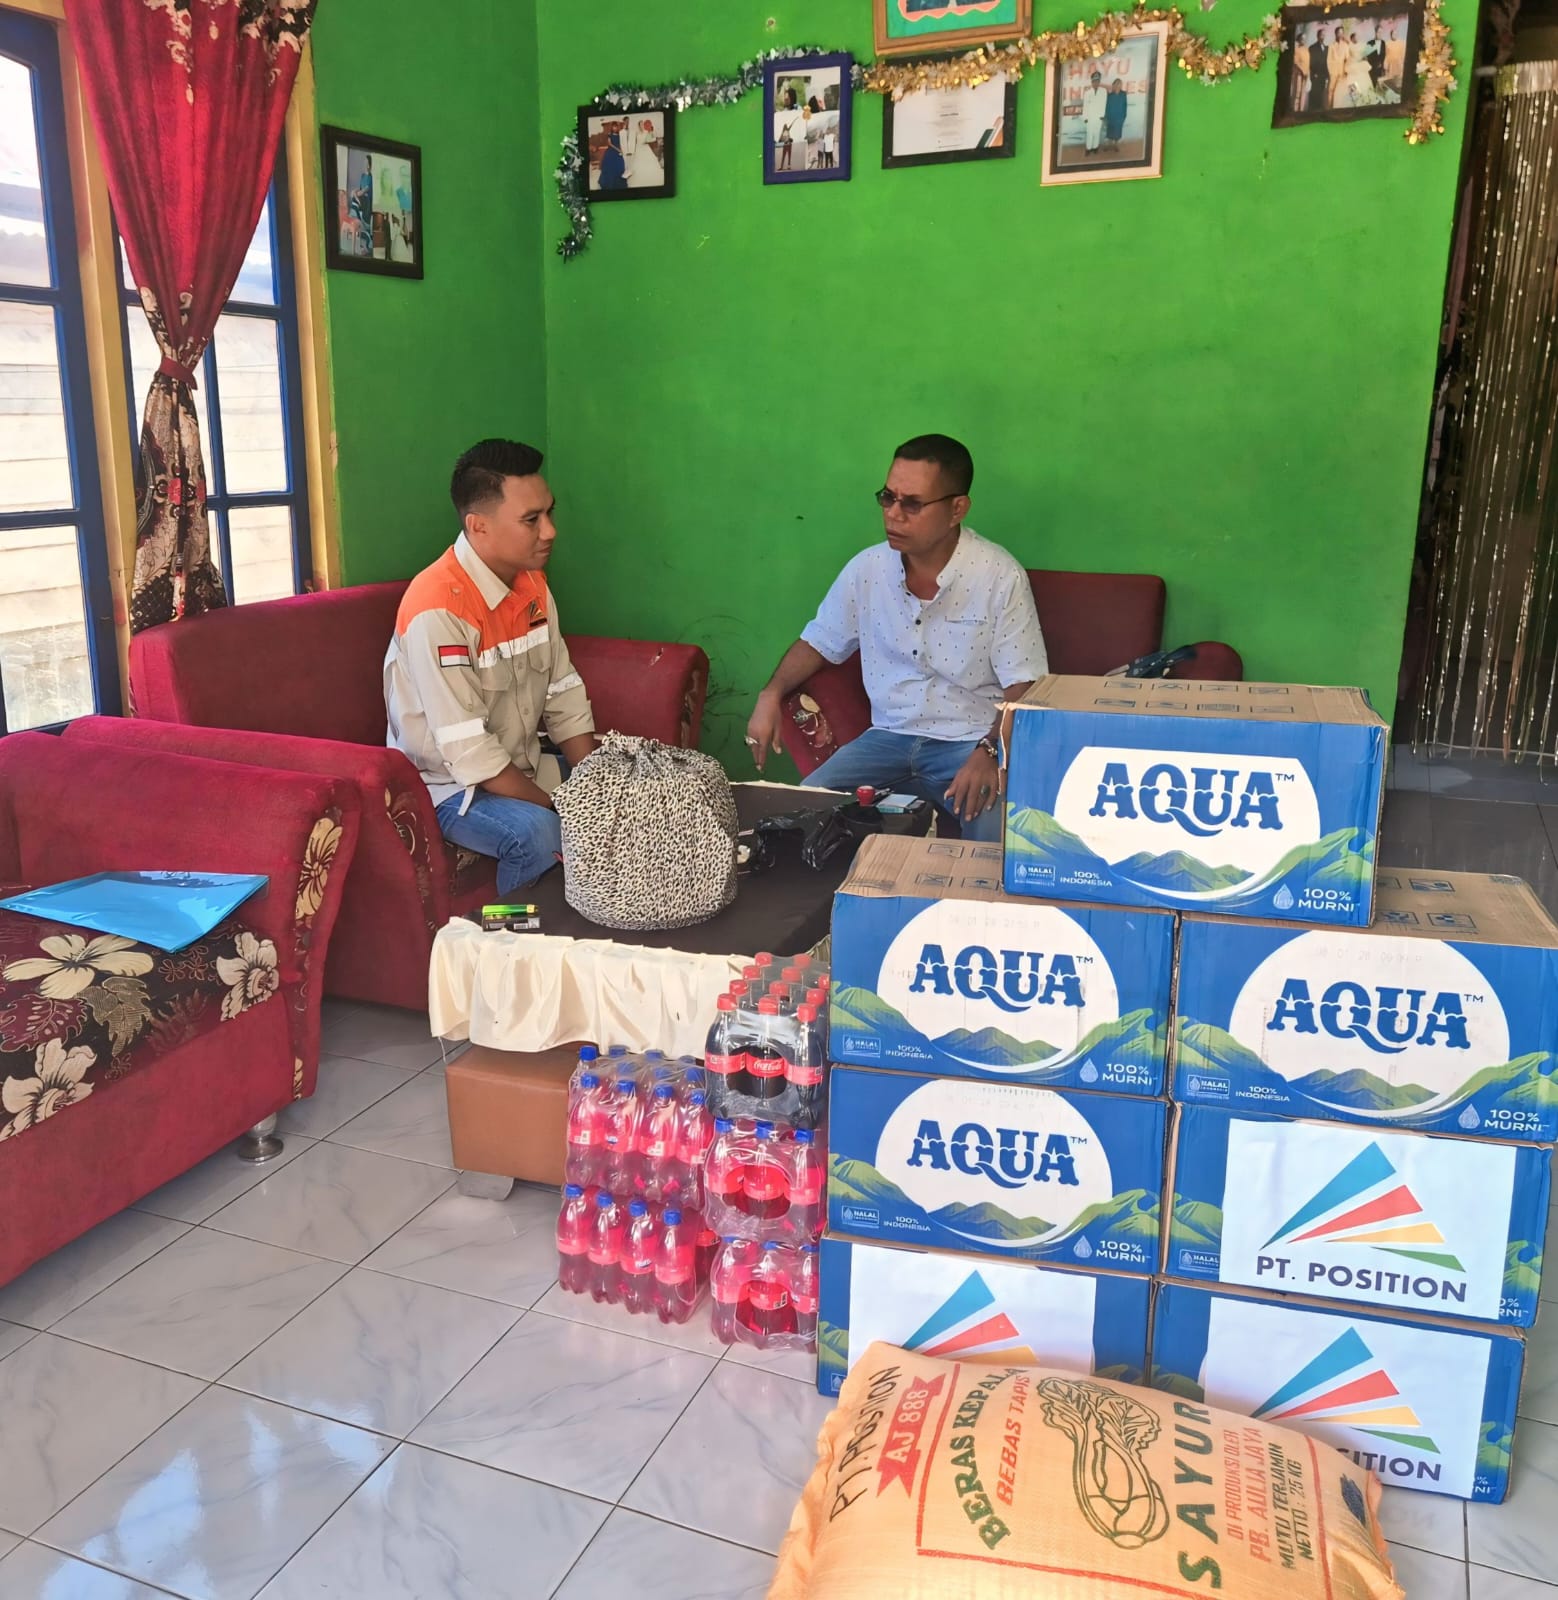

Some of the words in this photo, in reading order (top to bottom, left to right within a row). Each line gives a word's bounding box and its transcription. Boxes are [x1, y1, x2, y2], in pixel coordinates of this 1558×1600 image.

[1088, 762, 1283, 837] AQUA
[1060, 876, 1113, 887] INDONESIA
[1074, 871, 1100, 880] 100%
[1303, 888, 1352, 901] 100%
[1298, 899, 1355, 912] MURNI
[909, 943, 1086, 1013] AQUA
[1266, 977, 1471, 1054] AQUA
[885, 1049, 934, 1060] INDONESIA
[897, 1044, 922, 1053] 100%
[1105, 1063, 1149, 1076] 100%
[1102, 1073, 1152, 1086] MURNI
[1201, 1080, 1229, 1089] HALAL
[1235, 1091, 1291, 1102] INDONESIA
[1248, 1086, 1277, 1095] 100%
[1489, 1109, 1540, 1122] 100%
[1484, 1119, 1543, 1133] MURNI
[906, 1119, 1079, 1189] AQUA
[854, 1210, 877, 1218] HALAL
[895, 1216, 919, 1225] 100%
[883, 1220, 931, 1232] INDONESIA
[1096, 1249, 1146, 1264] MURNI
[1099, 1240, 1143, 1254] 100%
[1193, 1255, 1219, 1264] HALAL
[1256, 1255, 1296, 1281] PT.
[1308, 1261, 1468, 1303] POSITION
[1499, 1308, 1523, 1318] RNI
[897, 1388, 929, 1424] 888
[952, 1368, 1030, 1429] KEPALA
[885, 1430, 915, 1464] AJ
[996, 1418, 1022, 1507] BEBAS
[1009, 1375, 1031, 1414] TAPIS
[1223, 1429, 1241, 1457] OLEH
[1243, 1427, 1264, 1466] JAYA
[1287, 1459, 1303, 1479] KG
[1336, 1447, 1442, 1482] ITION
[1268, 1442, 1290, 1512] TERJAMIN
[950, 1434, 1011, 1550] BERAS
[1173, 1400, 1223, 1589] SAYUR
[1223, 1456, 1242, 1522] PRODUKSI
[1245, 1467, 1268, 1521] AULIA
[1288, 1477, 1306, 1500] 25
[1226, 1523, 1244, 1541] DI
[1248, 1528, 1272, 1563] PB.
[1274, 1515, 1297, 1569] MUTU
